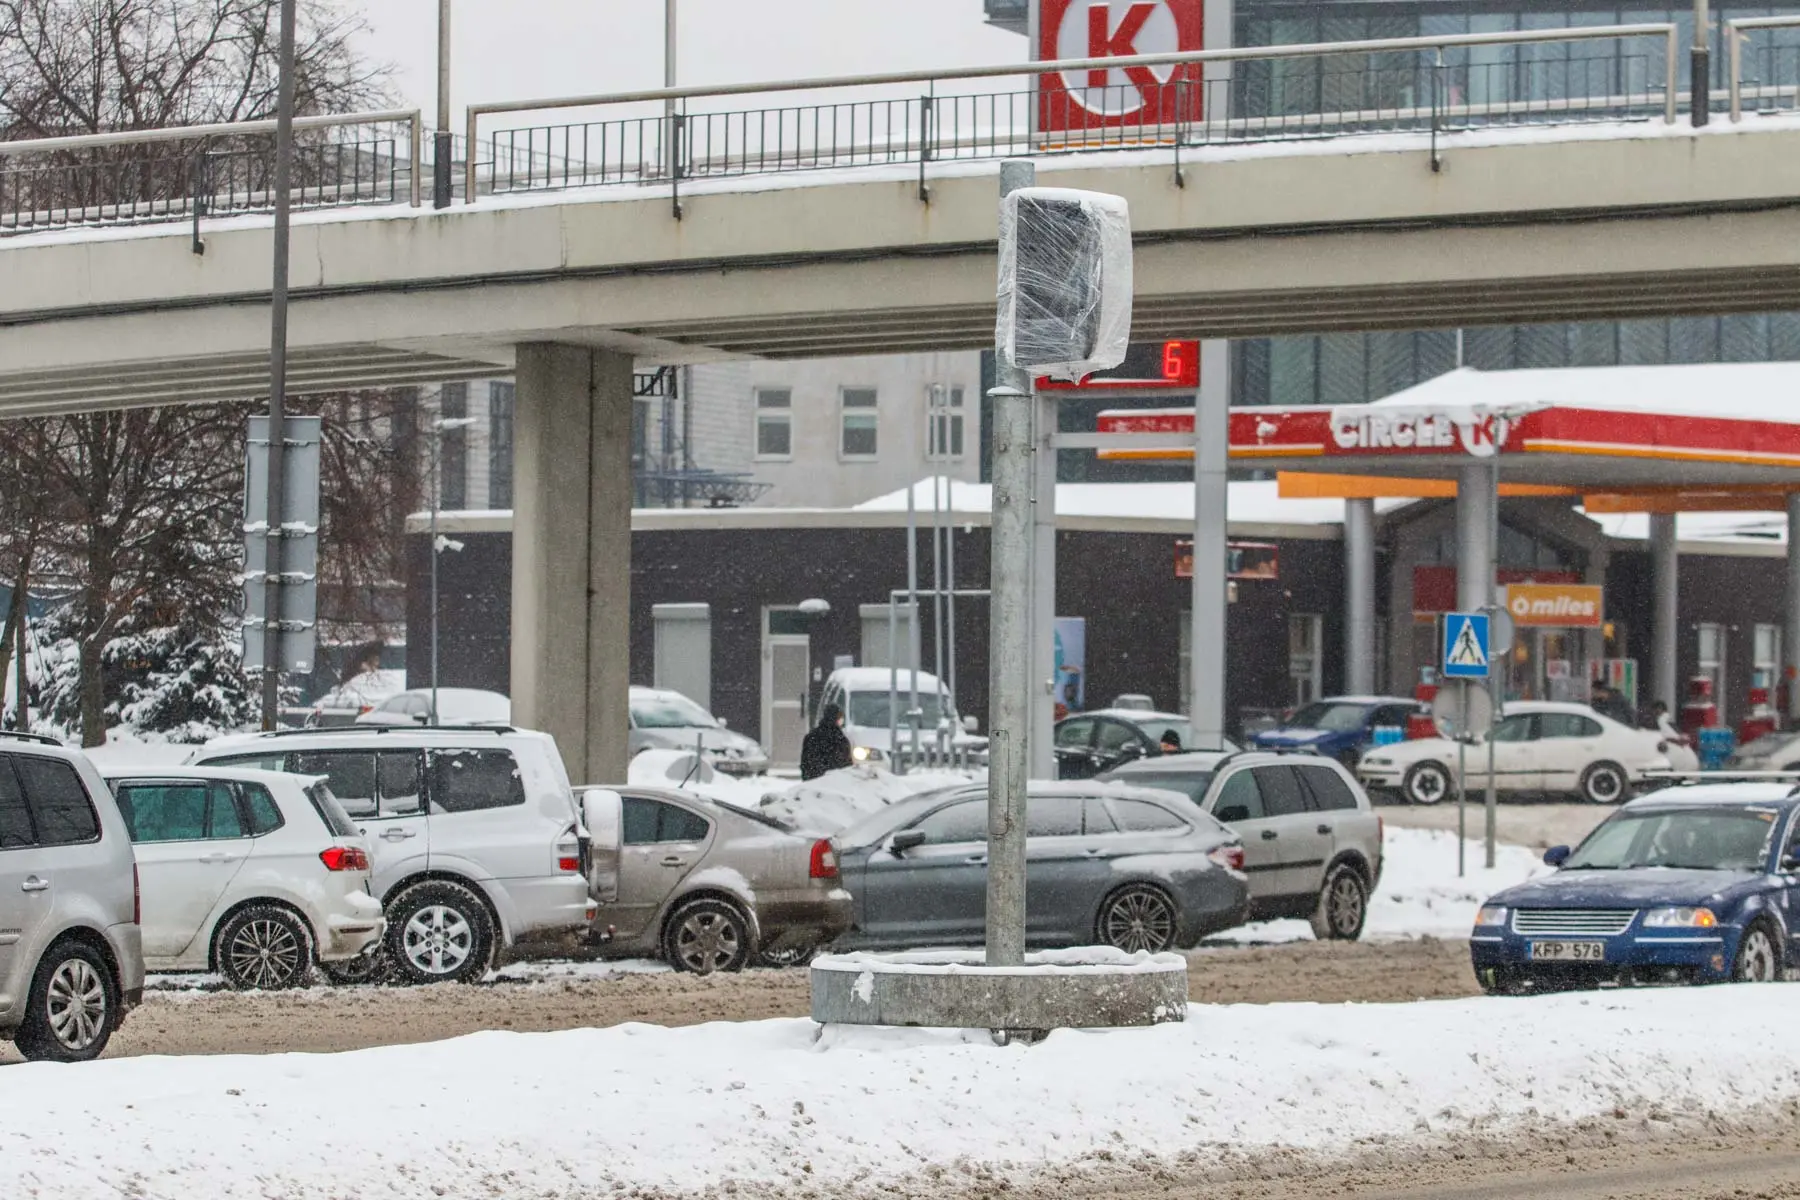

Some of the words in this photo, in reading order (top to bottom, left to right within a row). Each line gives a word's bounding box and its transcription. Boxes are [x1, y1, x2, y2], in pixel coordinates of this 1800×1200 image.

[1088, 4, 1164, 104] K
[1164, 342, 1182, 377] 6
[1333, 411, 1455, 448] CIRCLE
[1532, 596, 1595, 616] miles
[1533, 942, 1564, 958] KFP
[1573, 942, 1601, 958] 578
